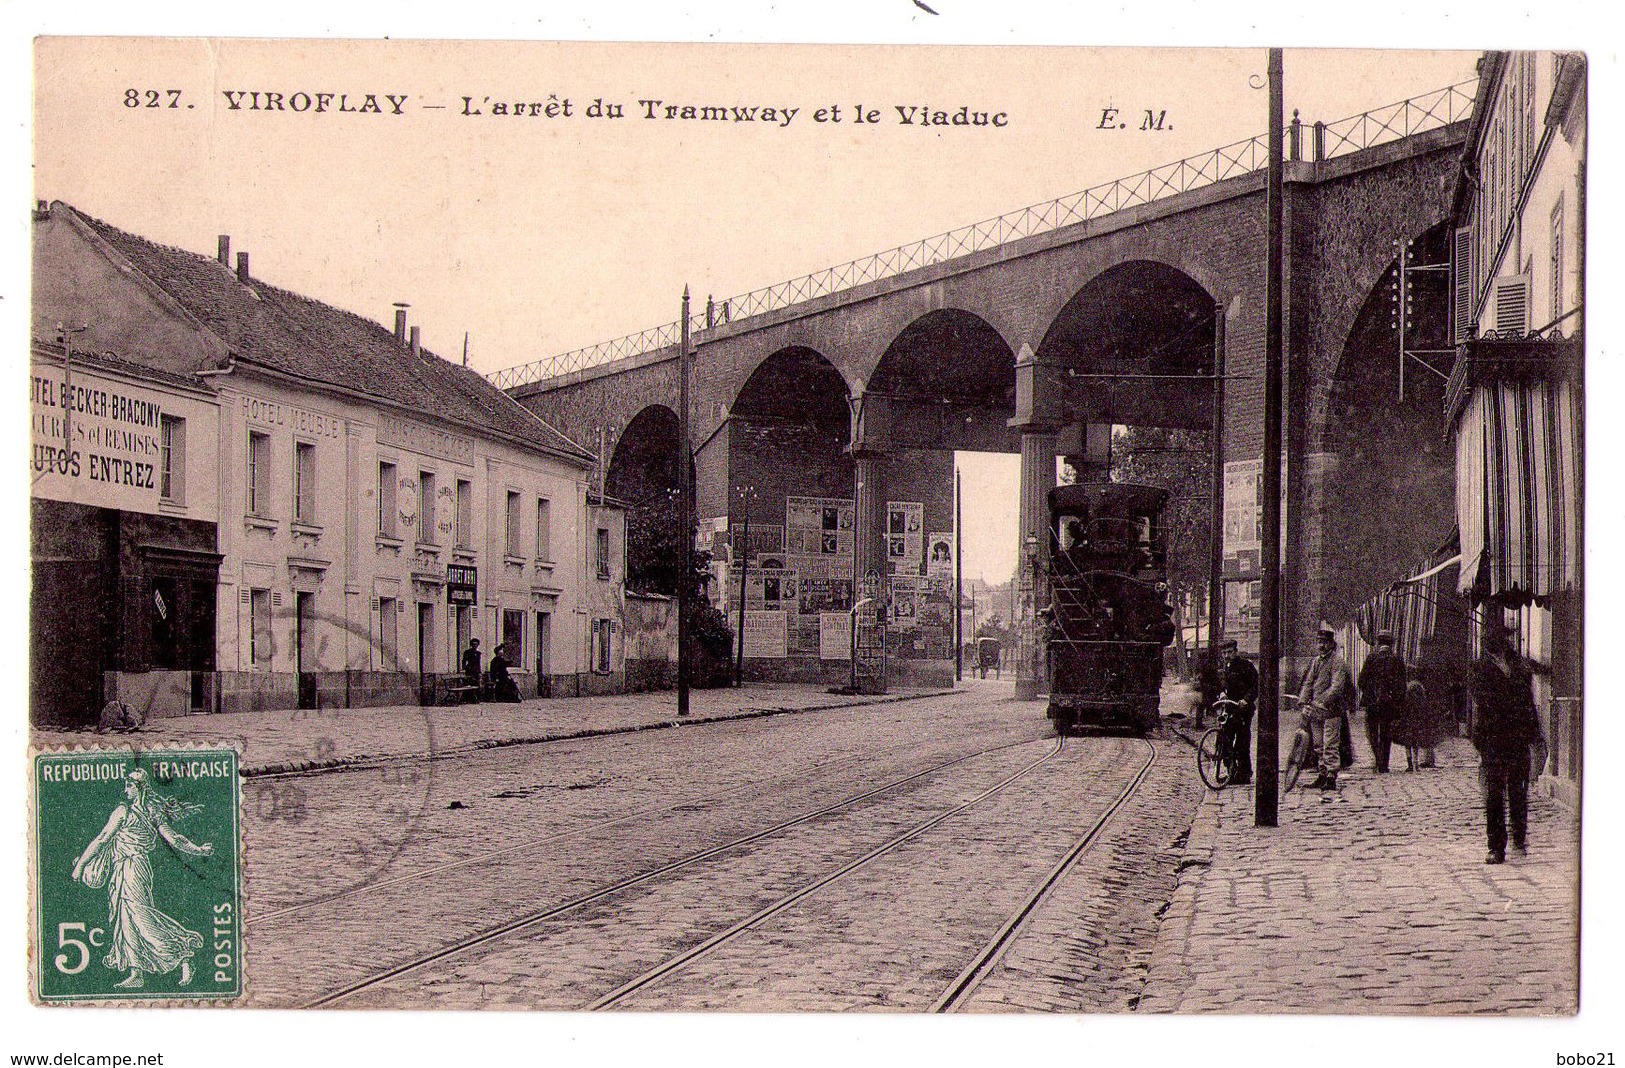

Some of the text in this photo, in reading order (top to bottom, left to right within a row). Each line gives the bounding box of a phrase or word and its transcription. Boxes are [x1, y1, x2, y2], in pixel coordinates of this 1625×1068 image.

[30, 376, 56, 407] TEL
[242, 397, 284, 425] HOTEL
[105, 427, 159, 457] REMISES
[30, 444, 154, 489] UTOS ENTREZ
[152, 760, 230, 781] FRANÇAISE
[213, 902, 233, 983] POSTES
